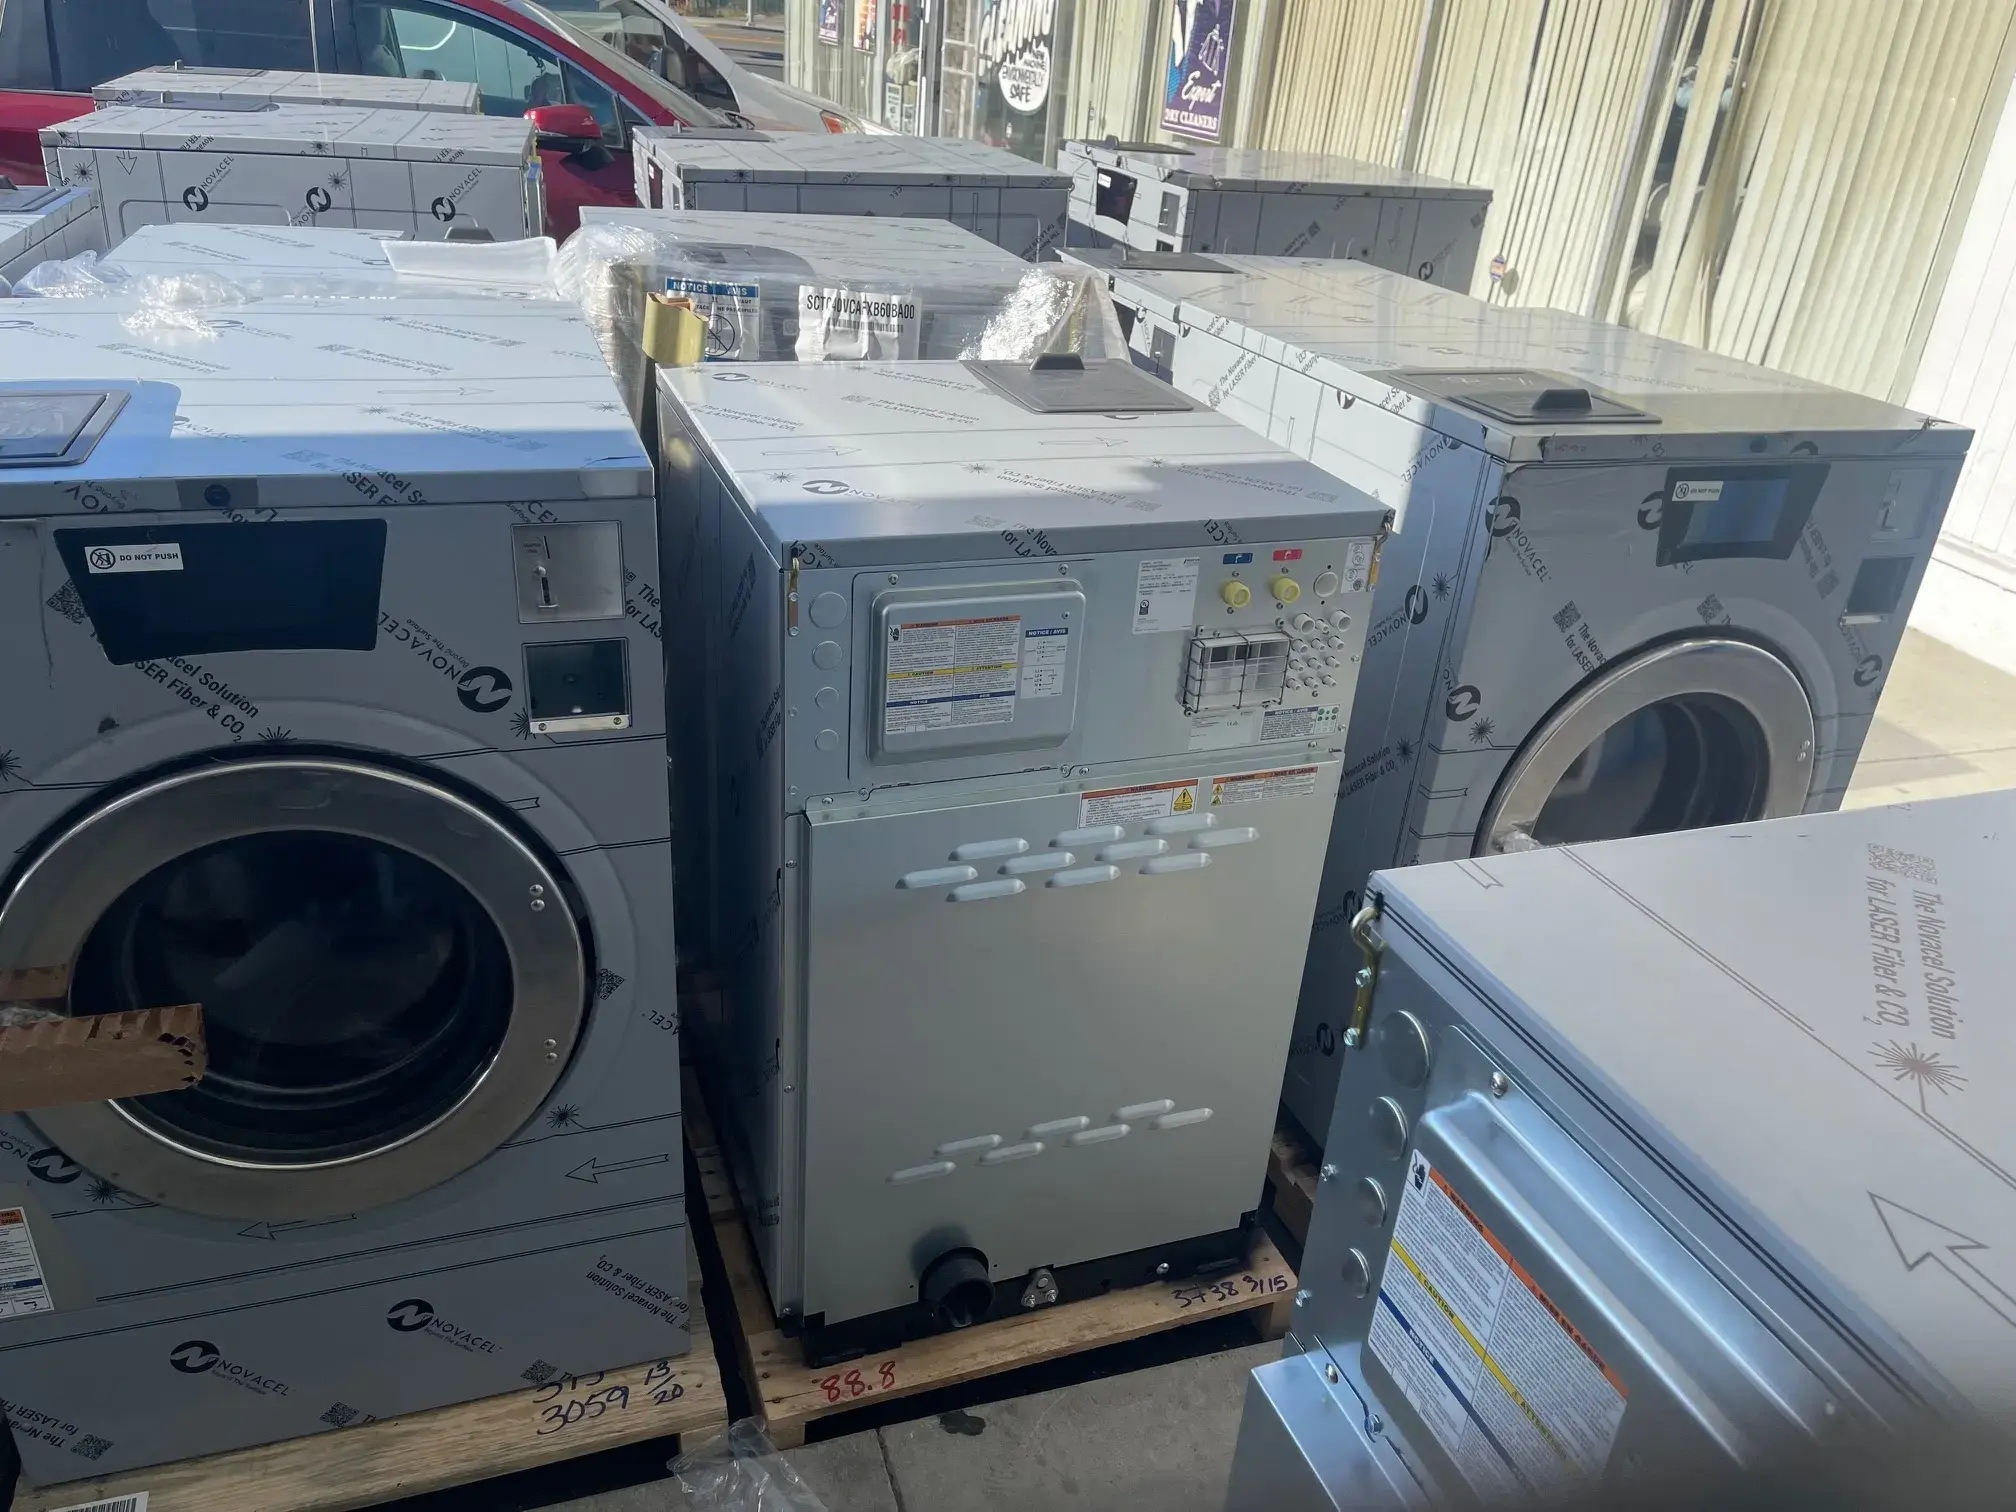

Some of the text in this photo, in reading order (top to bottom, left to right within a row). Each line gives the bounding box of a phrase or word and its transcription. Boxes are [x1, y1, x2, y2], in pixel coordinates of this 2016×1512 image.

[1009, 83, 1031, 103] SAFE
[1180, 111, 1217, 130] CLEANERS
[202, 155, 235, 191] NOVACEL
[449, 167, 482, 203] NOVACEL
[673, 282, 708, 293] NOTICE
[1227, 352, 1247, 376] Novacel
[1229, 370, 1246, 391] LASER
[1244, 355, 1257, 373] Fiber
[1401, 438, 1449, 483] NOVACEL
[155, 552, 179, 560] PUSH
[1512, 527, 1546, 583] NOVACEL
[626, 600, 646, 618] for
[638, 583, 660, 606] The
[406, 618, 432, 640] Surface
[1367, 613, 1409, 649] NOVACEL
[1564, 634, 1574, 650] for
[1578, 622, 1591, 642] The
[378, 611, 462, 682] NOVACEL
[432, 638, 445, 651] The
[166, 676, 208, 710] Fiber
[206, 703, 222, 720] &
[199, 672, 259, 719] Solution
[1366, 746, 1391, 769] Solution
[1345, 775, 1366, 797] LASER
[1865, 876, 1897, 898] for
[1867, 896, 1901, 945] LASER
[1871, 942, 1907, 985] Fiber
[1912, 889, 1964, 1041] The Novacel Solution
[1874, 983, 1907, 998] &
[1448, 1191, 1484, 1234] WARNING
[612, 1266, 623, 1277] &
[622, 1270, 647, 1291] Fiber
[586, 1270, 678, 1325] The Novacel Solution
[675, 1302, 691, 1315] for
[1422, 1278, 1456, 1320] CAUTION
[430, 1318, 497, 1354] NOVACEL
[1407, 1328, 1438, 1368] NOTICE
[216, 1359, 288, 1397] NOVACEL
[233, 1377, 245, 1388] The
[820, 1360, 896, 1402] 88.8
[16, 1406, 80, 1436] for LASER
[536, 1385, 630, 1436] 3059
[43, 1431, 66, 1449] The
